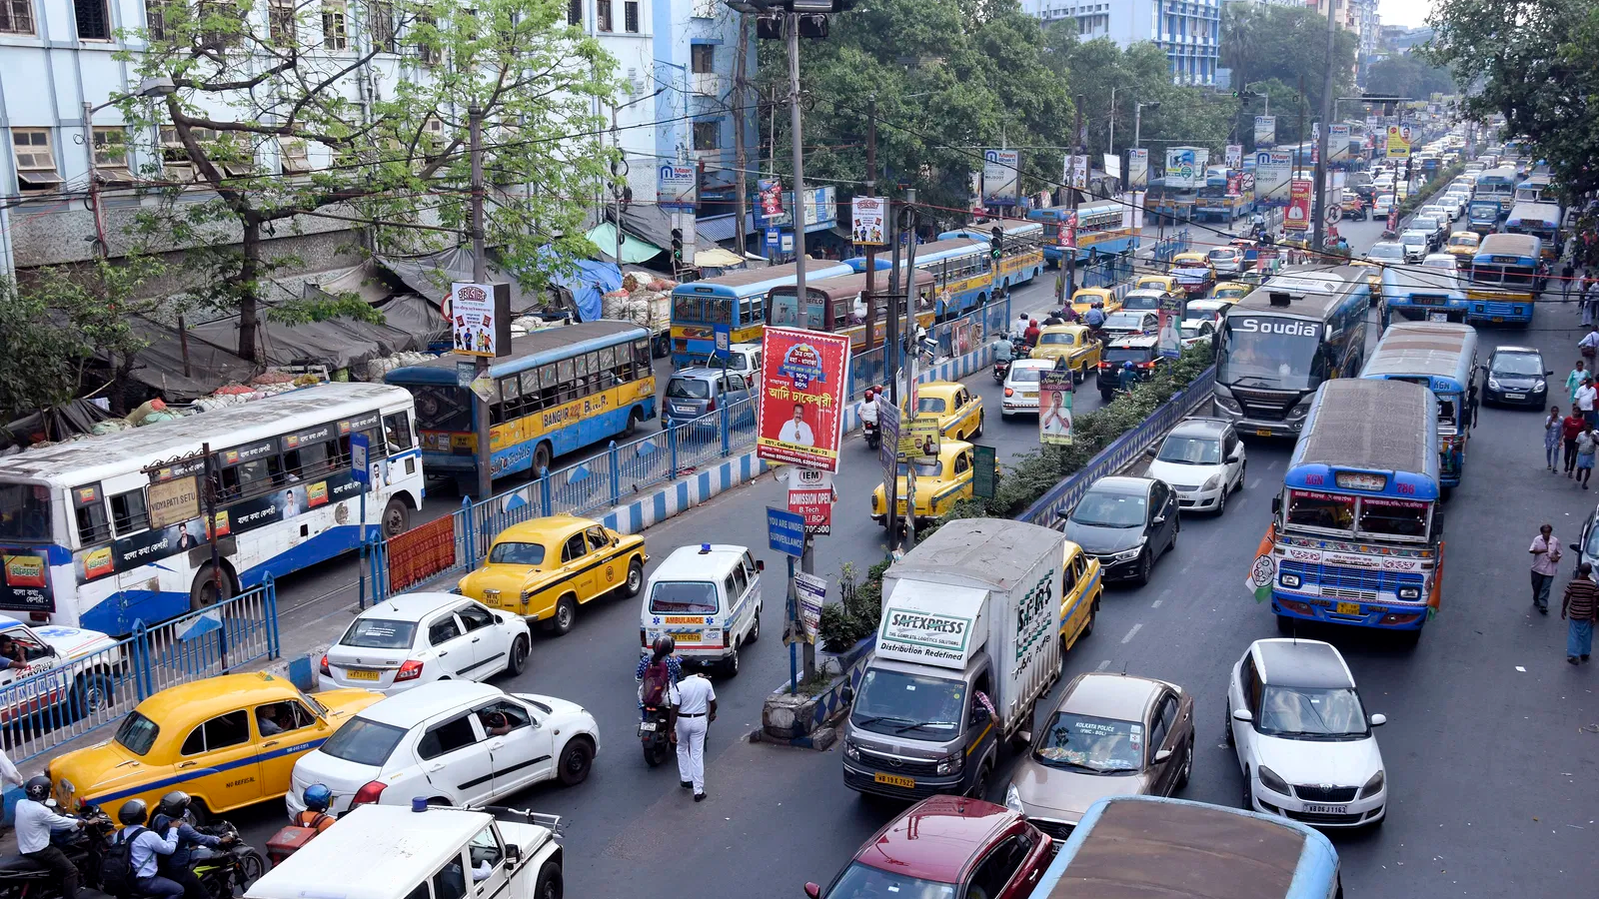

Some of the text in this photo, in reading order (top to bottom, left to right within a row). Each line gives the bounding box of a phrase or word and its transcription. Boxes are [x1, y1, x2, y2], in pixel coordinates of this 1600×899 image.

[1232, 319, 1319, 336] Soudia
[768, 386, 790, 400] আদি
[544, 407, 568, 427] BANGUR
[802, 471, 819, 480] IEM
[1305, 474, 1324, 485] KGN
[1396, 482, 1416, 495] 786
[151, 492, 196, 512] VIDYAPATI SETU
[790, 492, 831, 504] ADMISSION OPEN
[769, 516, 804, 532] YOU ARE UNDER
[770, 532, 802, 548] SURVEILLANCE
[666, 616, 704, 624] AMBULANCE
[892, 614, 964, 634] SAFEXPRESS
[881, 642, 963, 660] Distribution Redefined
[1075, 722, 1115, 732] KOLKATA POLICE
[234, 776, 255, 786] REFUSAL
